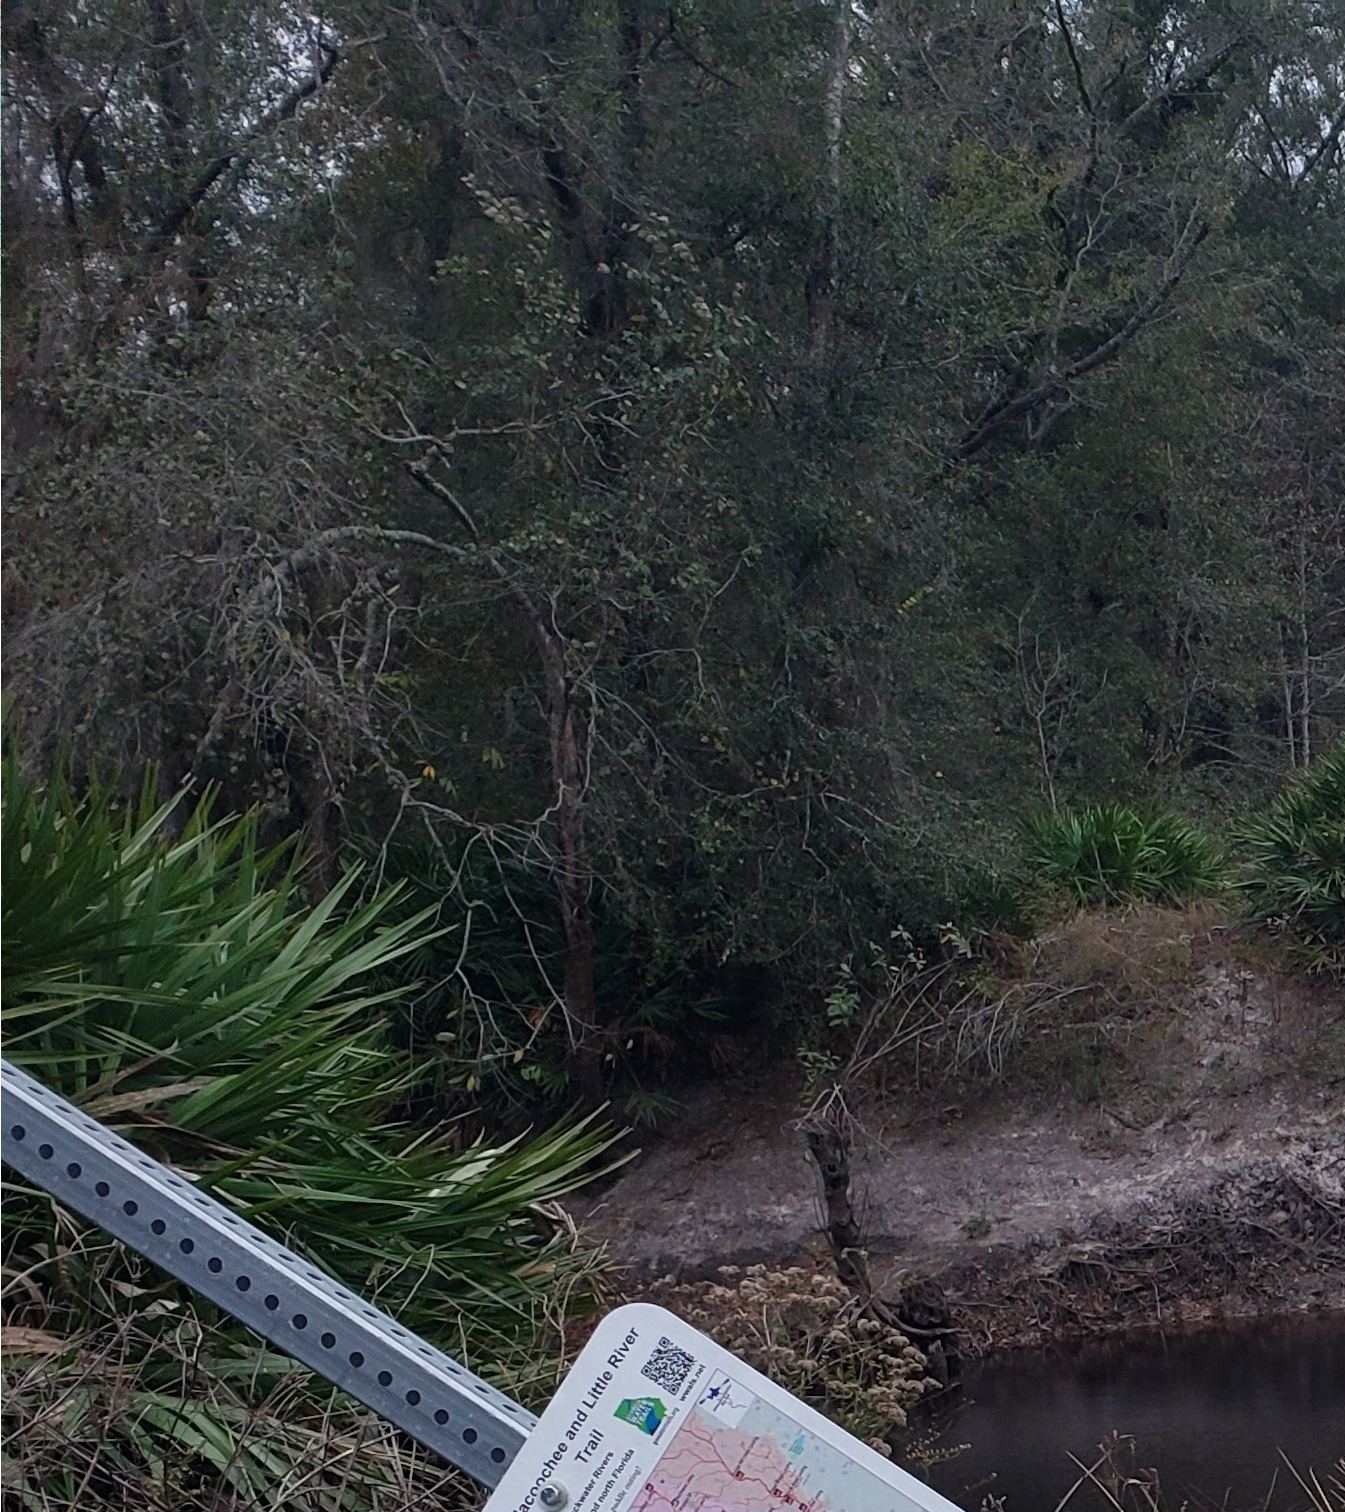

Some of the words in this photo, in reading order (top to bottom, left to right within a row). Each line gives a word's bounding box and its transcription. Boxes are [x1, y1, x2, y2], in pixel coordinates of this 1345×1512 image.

[564, 1407, 589, 1441] and
[580, 1369, 613, 1410] Little
[605, 1325, 640, 1370] River
[677, 1362, 707, 1402] wwals.net
[631, 1399, 648, 1422] WATER
[636, 1401, 654, 1425] TRAILS
[572, 1427, 605, 1464] Trail
[591, 1450, 614, 1480] Rivers
[596, 1478, 616, 1504] north
[610, 1447, 635, 1480] Florida
